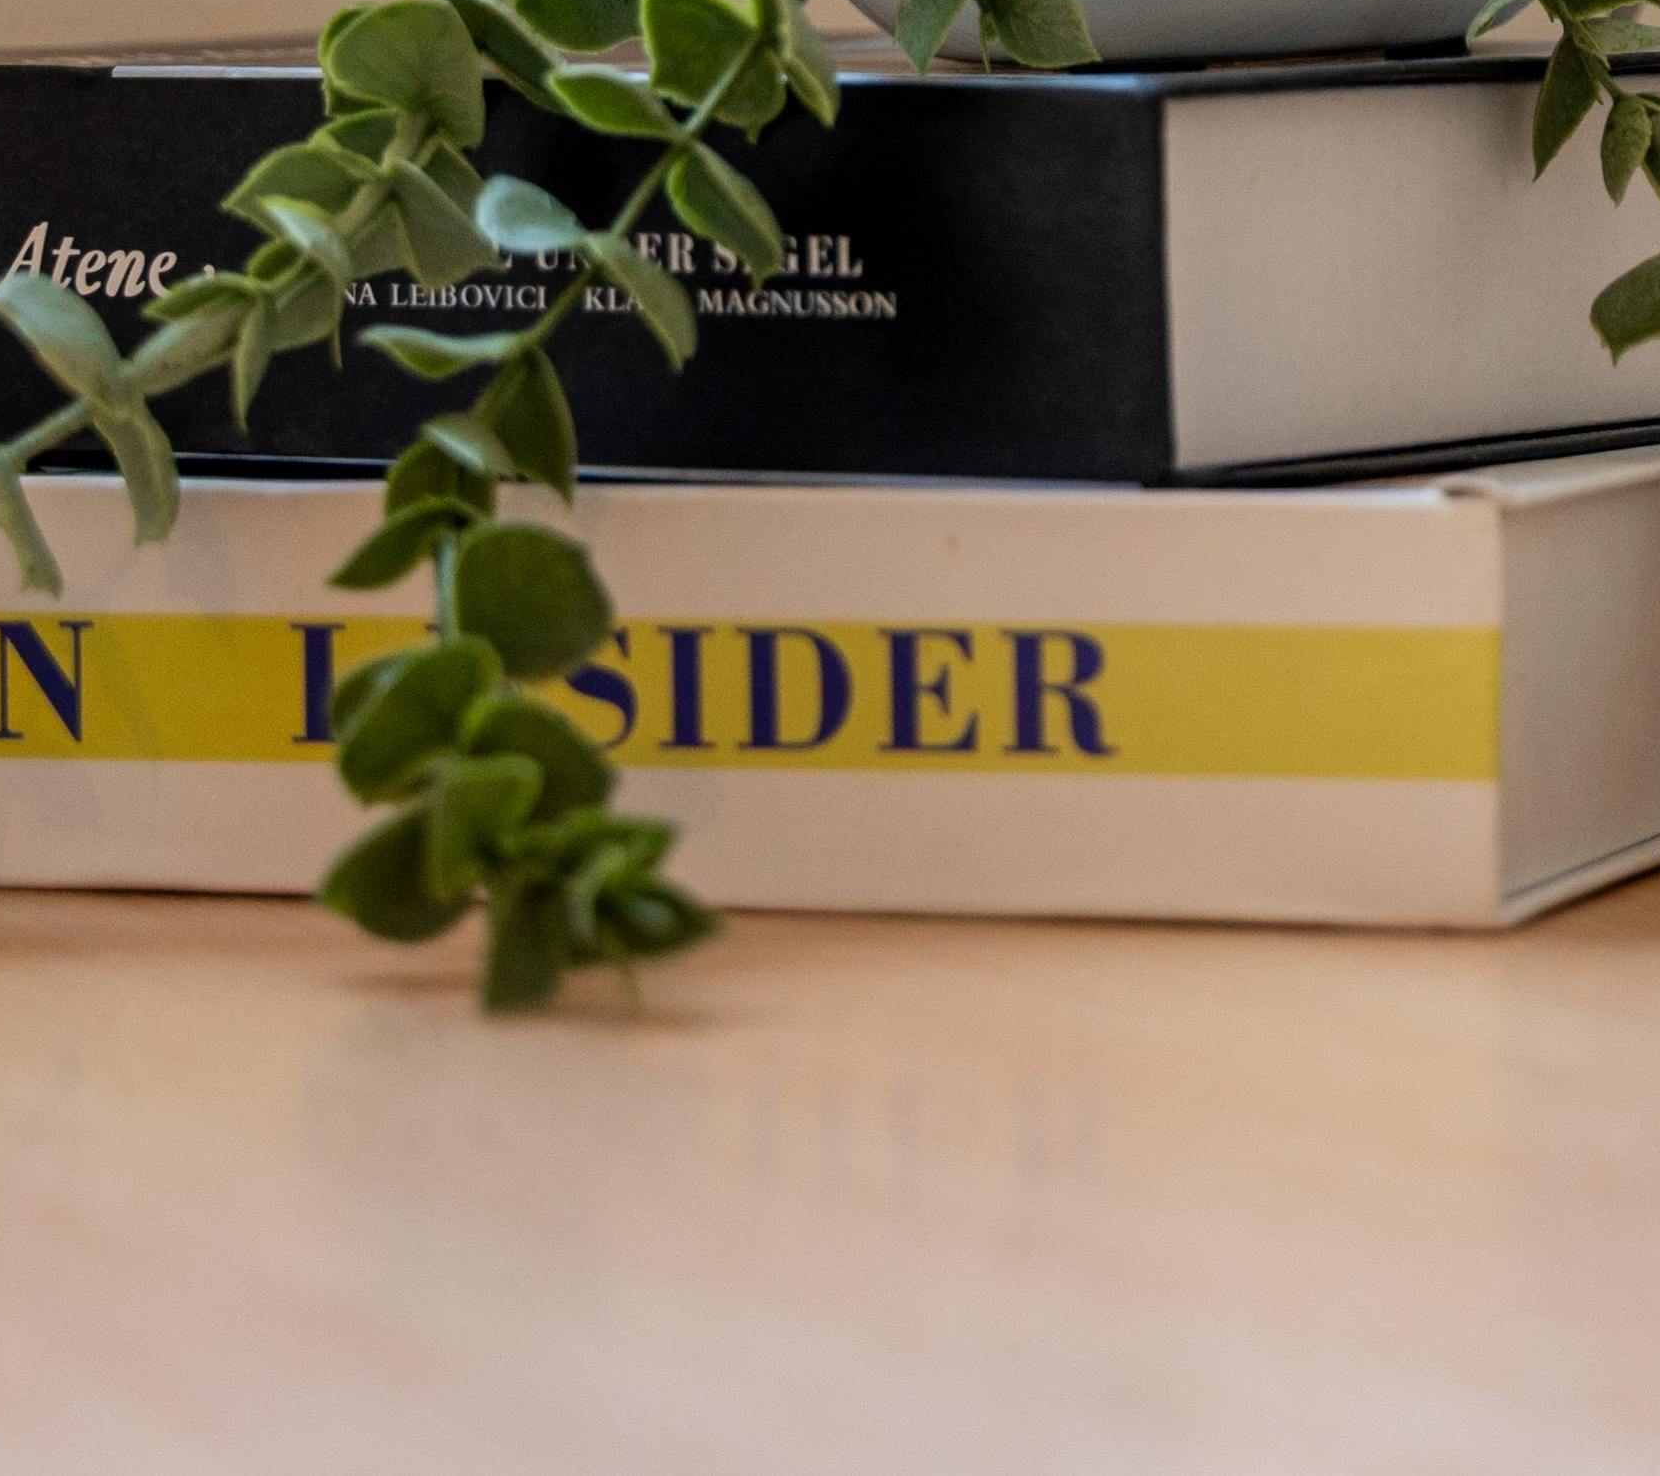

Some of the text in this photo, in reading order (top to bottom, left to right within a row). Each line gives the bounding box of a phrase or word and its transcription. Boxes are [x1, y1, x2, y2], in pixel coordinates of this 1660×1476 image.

[712, 234, 864, 278] SGEL
[390, 283, 547, 310] LEIBOVICI
[697, 288, 898, 318] MAGNUSSON
[290, 623, 1119, 755] ISIDER
